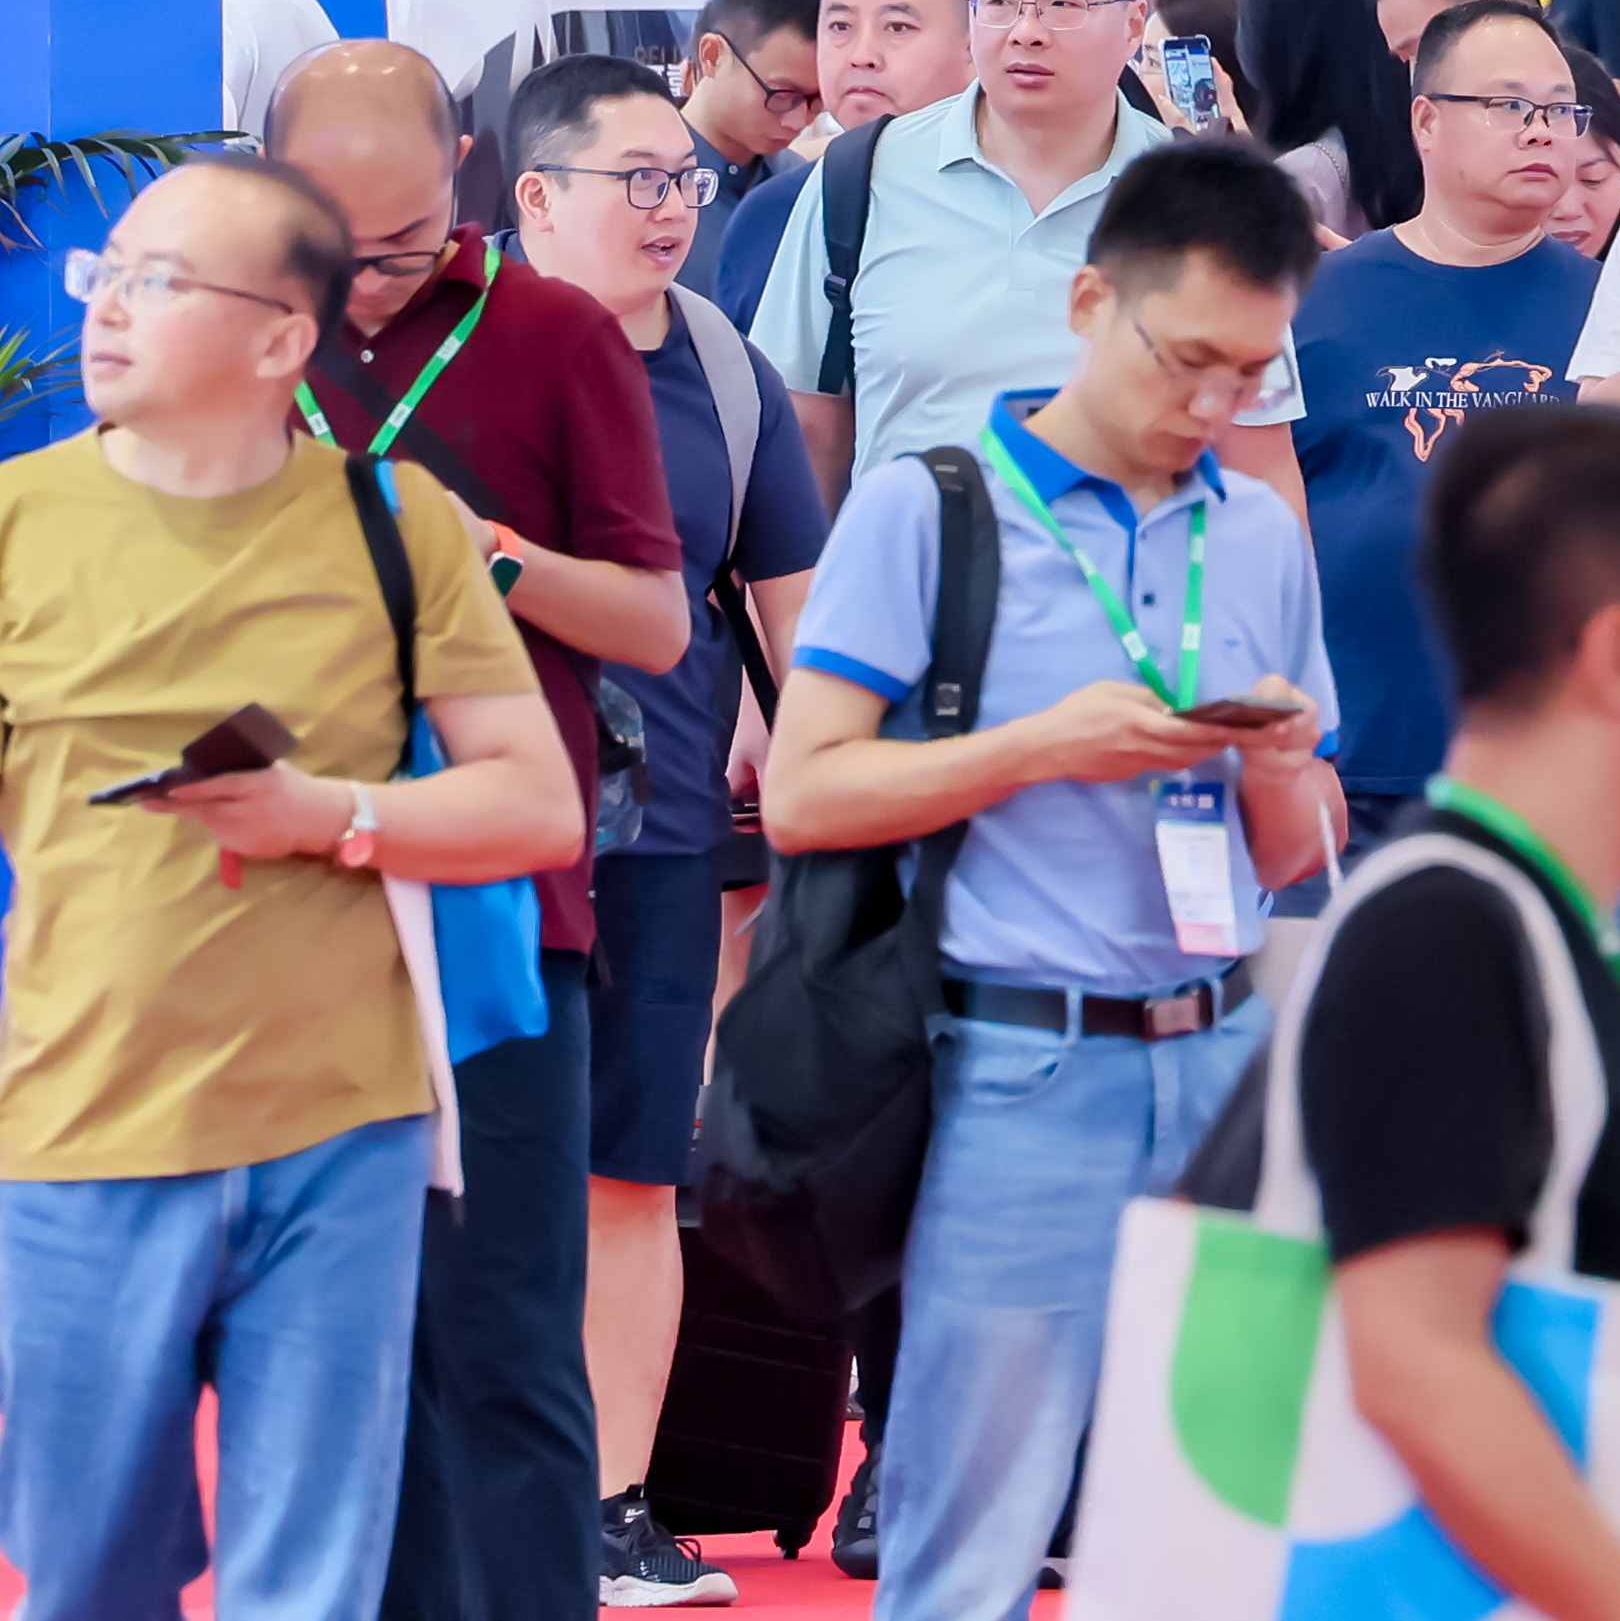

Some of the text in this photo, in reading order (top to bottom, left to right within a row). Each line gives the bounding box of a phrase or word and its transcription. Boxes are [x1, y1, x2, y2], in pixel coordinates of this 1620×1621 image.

[1366, 392, 1411, 408] WALK
[1416, 392, 1433, 408] IN
[1436, 392, 1468, 408] THE
